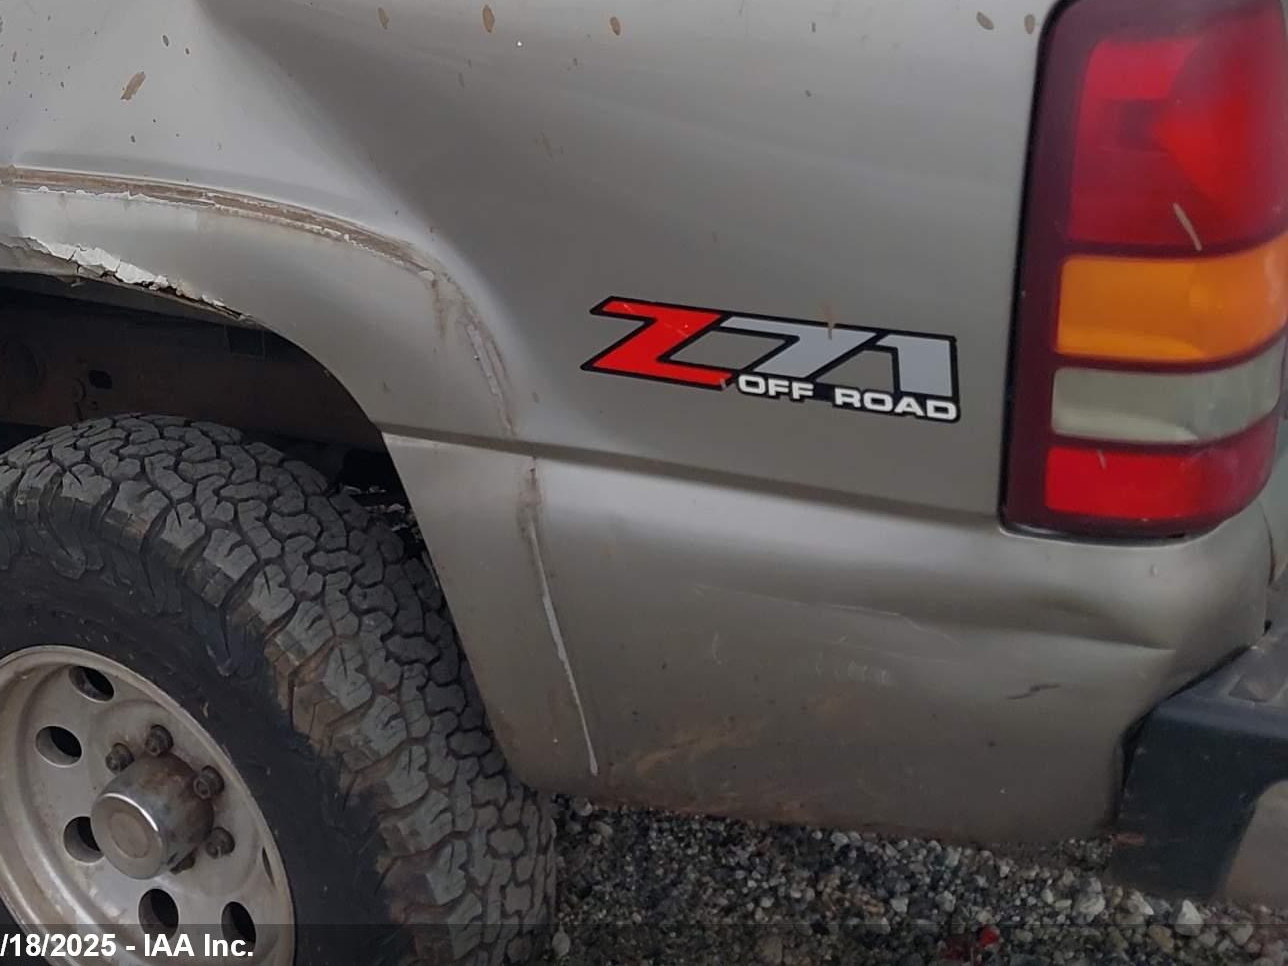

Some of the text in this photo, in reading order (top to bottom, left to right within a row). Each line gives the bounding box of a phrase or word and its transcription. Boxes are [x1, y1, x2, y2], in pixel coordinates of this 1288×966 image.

[580, 296, 959, 398] Z71
[736, 373, 959, 421] OFF ROAD
